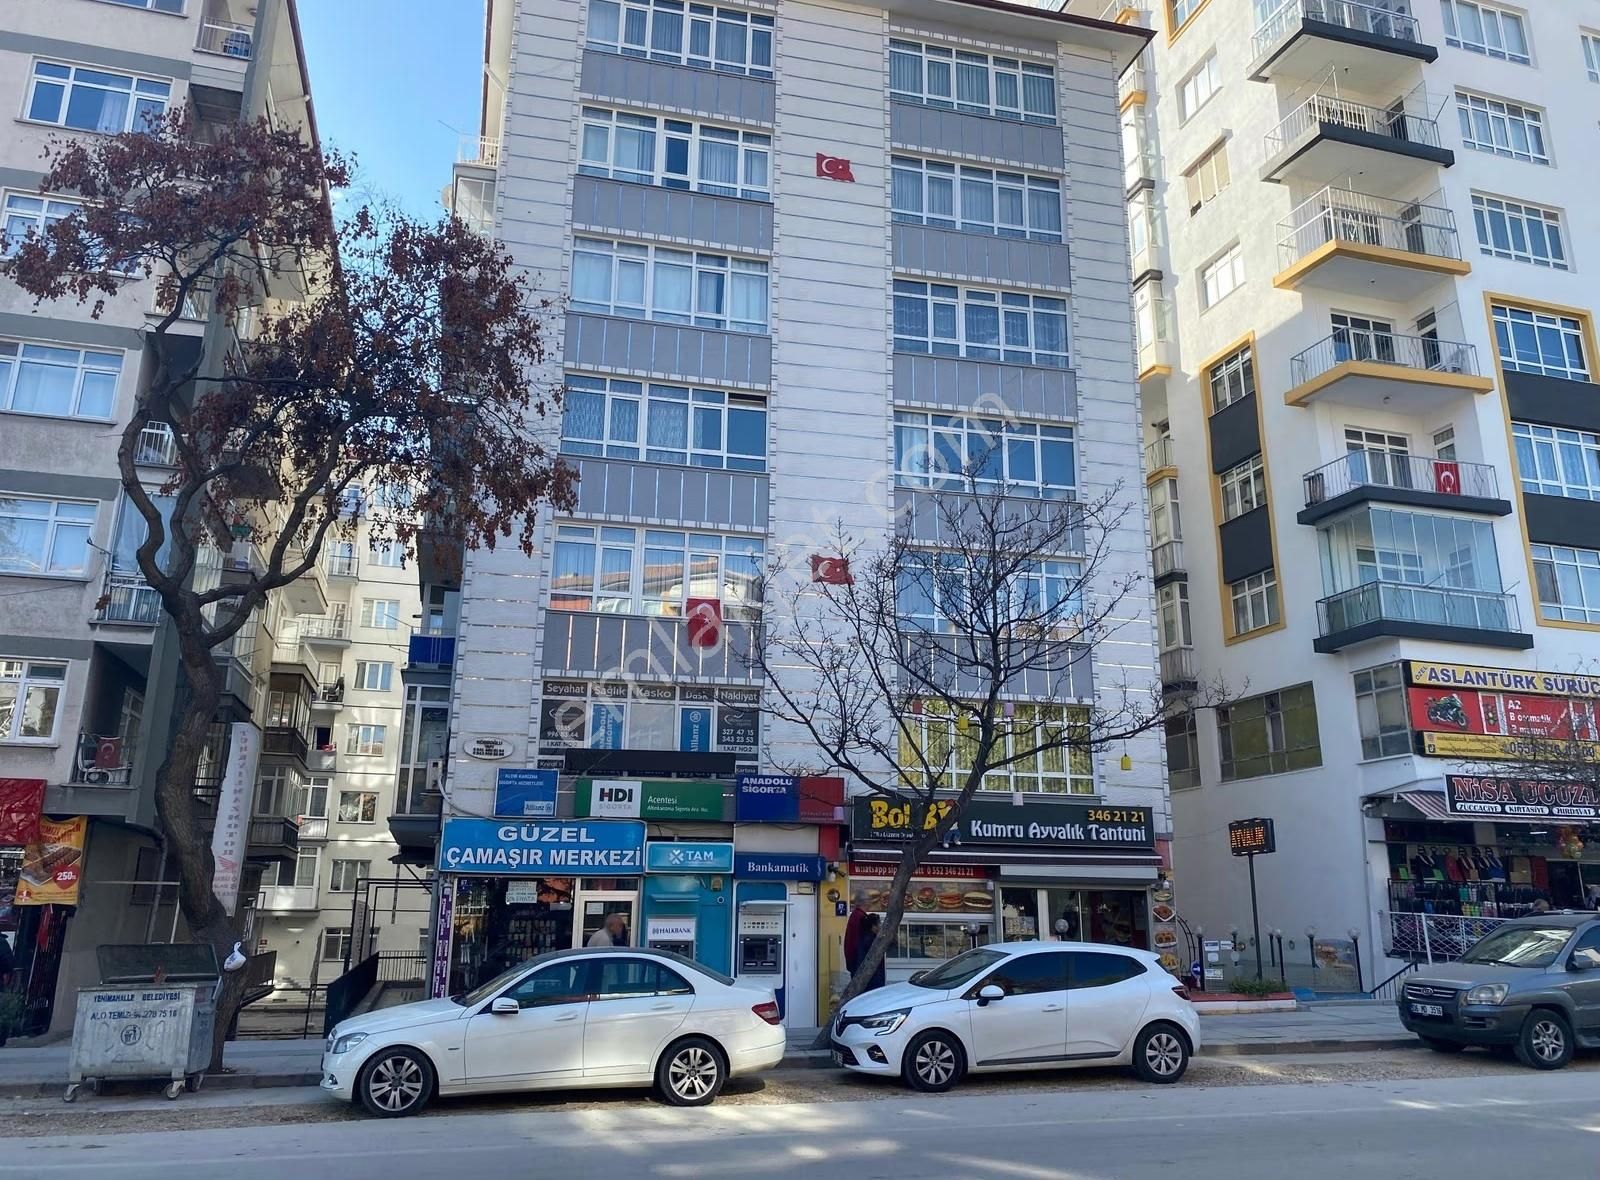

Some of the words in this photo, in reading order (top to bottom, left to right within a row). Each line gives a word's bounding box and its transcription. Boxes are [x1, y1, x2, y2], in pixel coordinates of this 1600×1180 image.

[1428, 668, 1538, 690] ASLANTÜRK
[546, 684, 584, 694] Seyahat
[636, 687, 671, 698] Kasko
[720, 691, 758, 702] Nakliyat
[742, 778, 792, 786] ANADOLU
[599, 788, 632, 802] HDI
[648, 796, 678, 804] Acentesi
[1088, 810, 1110, 822] 346
[1114, 811, 1126, 822] 21
[1131, 812, 1145, 823] 21
[498, 824, 596, 842] GÜZEL
[970, 820, 1024, 838] Kumru
[1028, 822, 1085, 840] Ayvalık
[1088, 824, 1146, 842] Tantuni
[446, 847, 542, 868] ÇAMAŞIR
[550, 846, 641, 866] MERKEZİ
[686, 850, 714, 860] TAM
[747, 862, 809, 873] Bankamatik
[56, 872, 72, 880] 250
[660, 926, 692, 934] HALKBANK
[142, 991, 180, 1002] BELEDİYESİ
